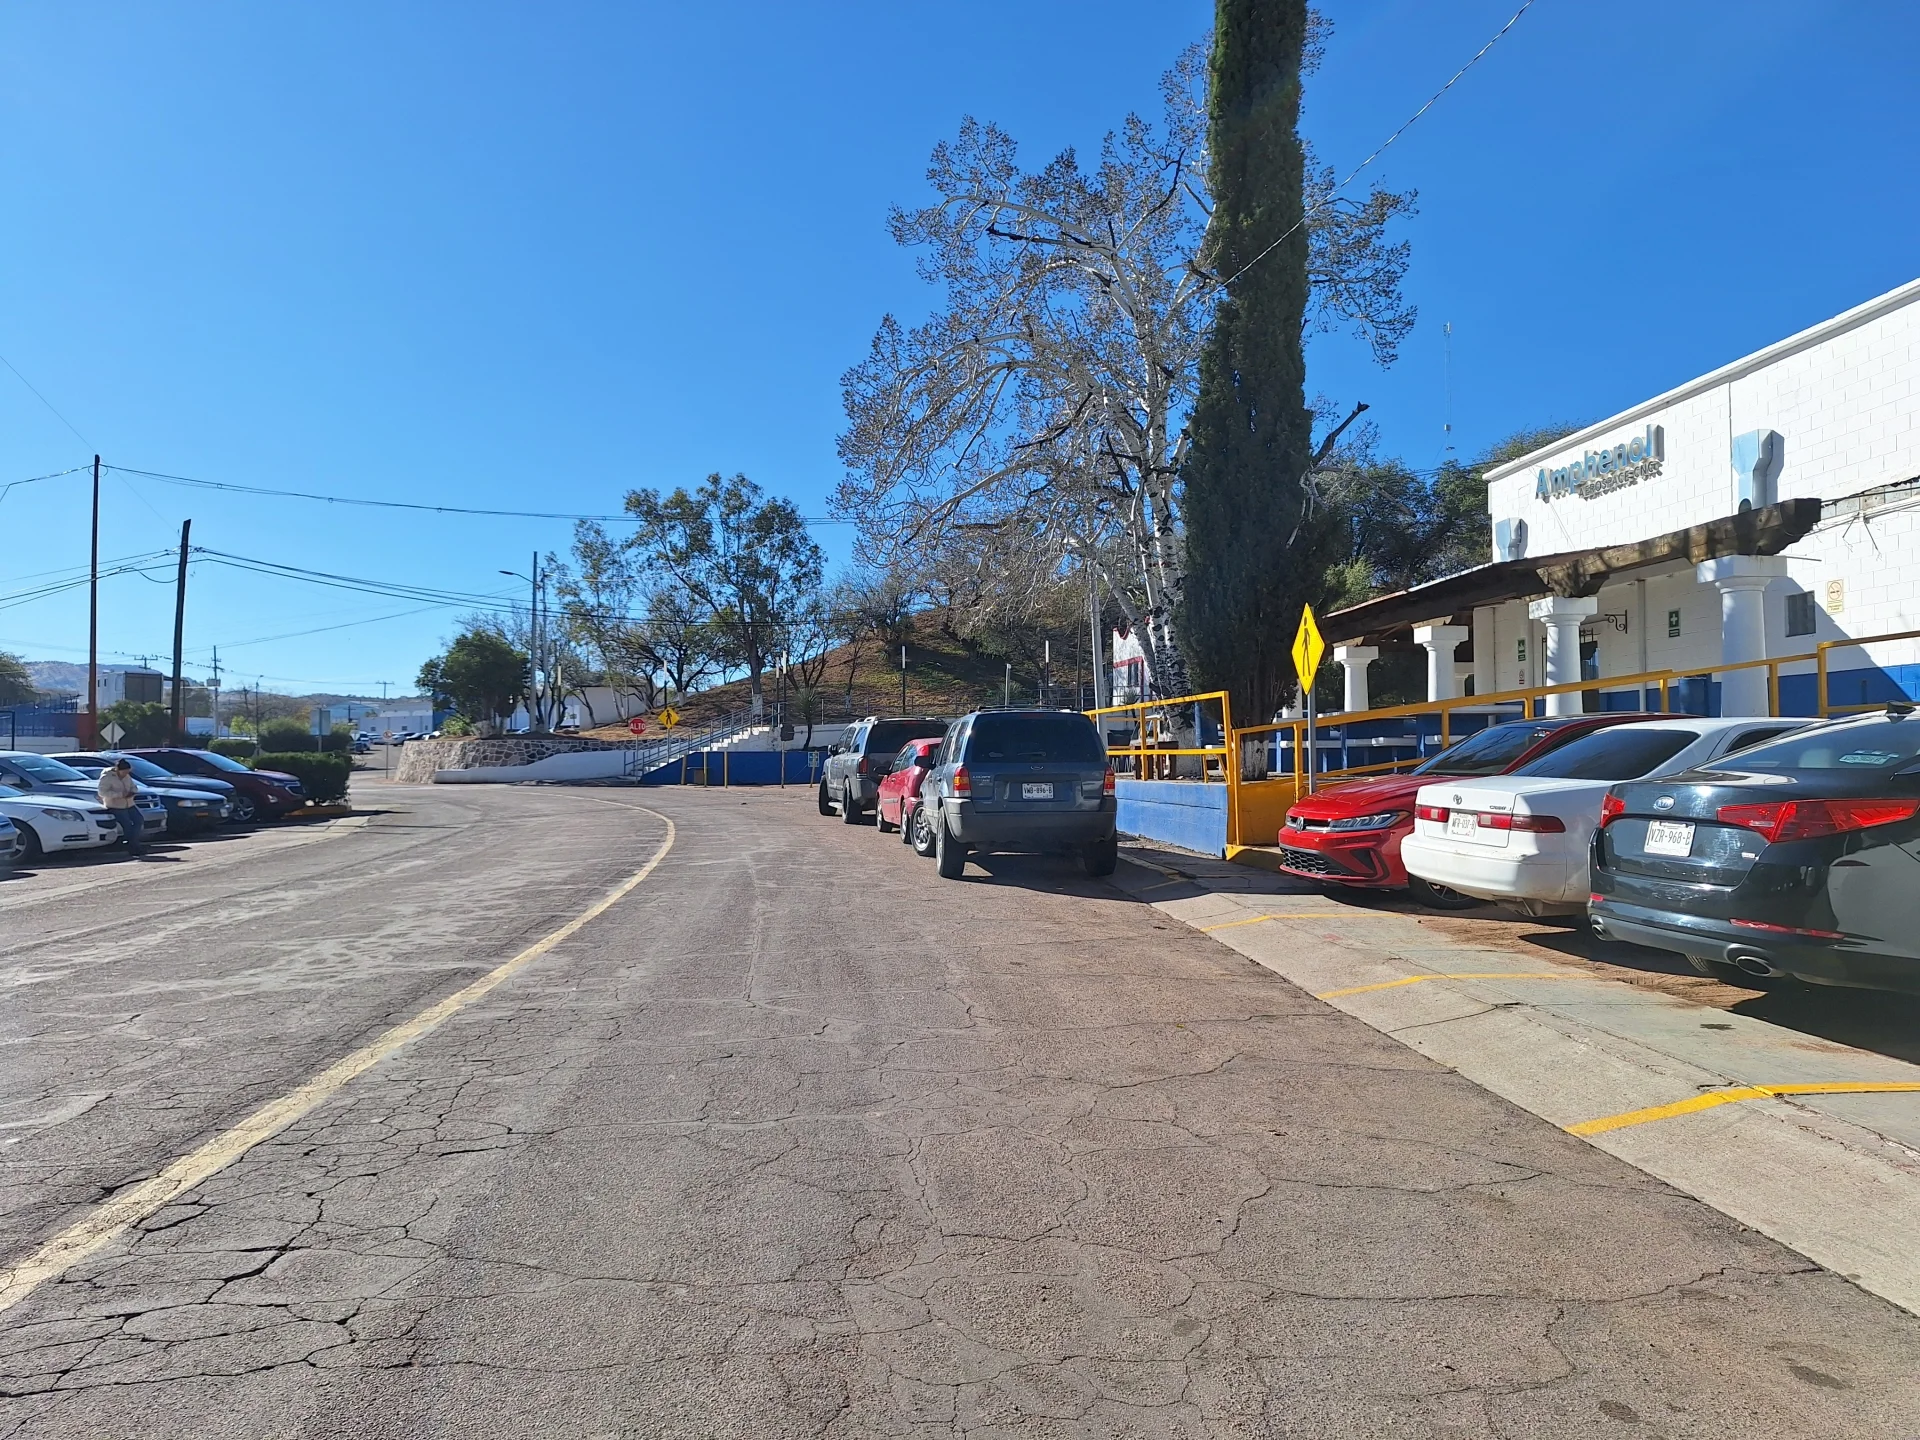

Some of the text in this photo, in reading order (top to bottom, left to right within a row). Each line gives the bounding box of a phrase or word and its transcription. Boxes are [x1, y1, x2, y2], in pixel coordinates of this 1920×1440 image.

[1535, 424, 1661, 500] Amphenol
[1578, 469, 1631, 499] AEROSPACE
[630, 722, 645, 730] ALTO
[1650, 828, 1692, 845] VZR-968-B
